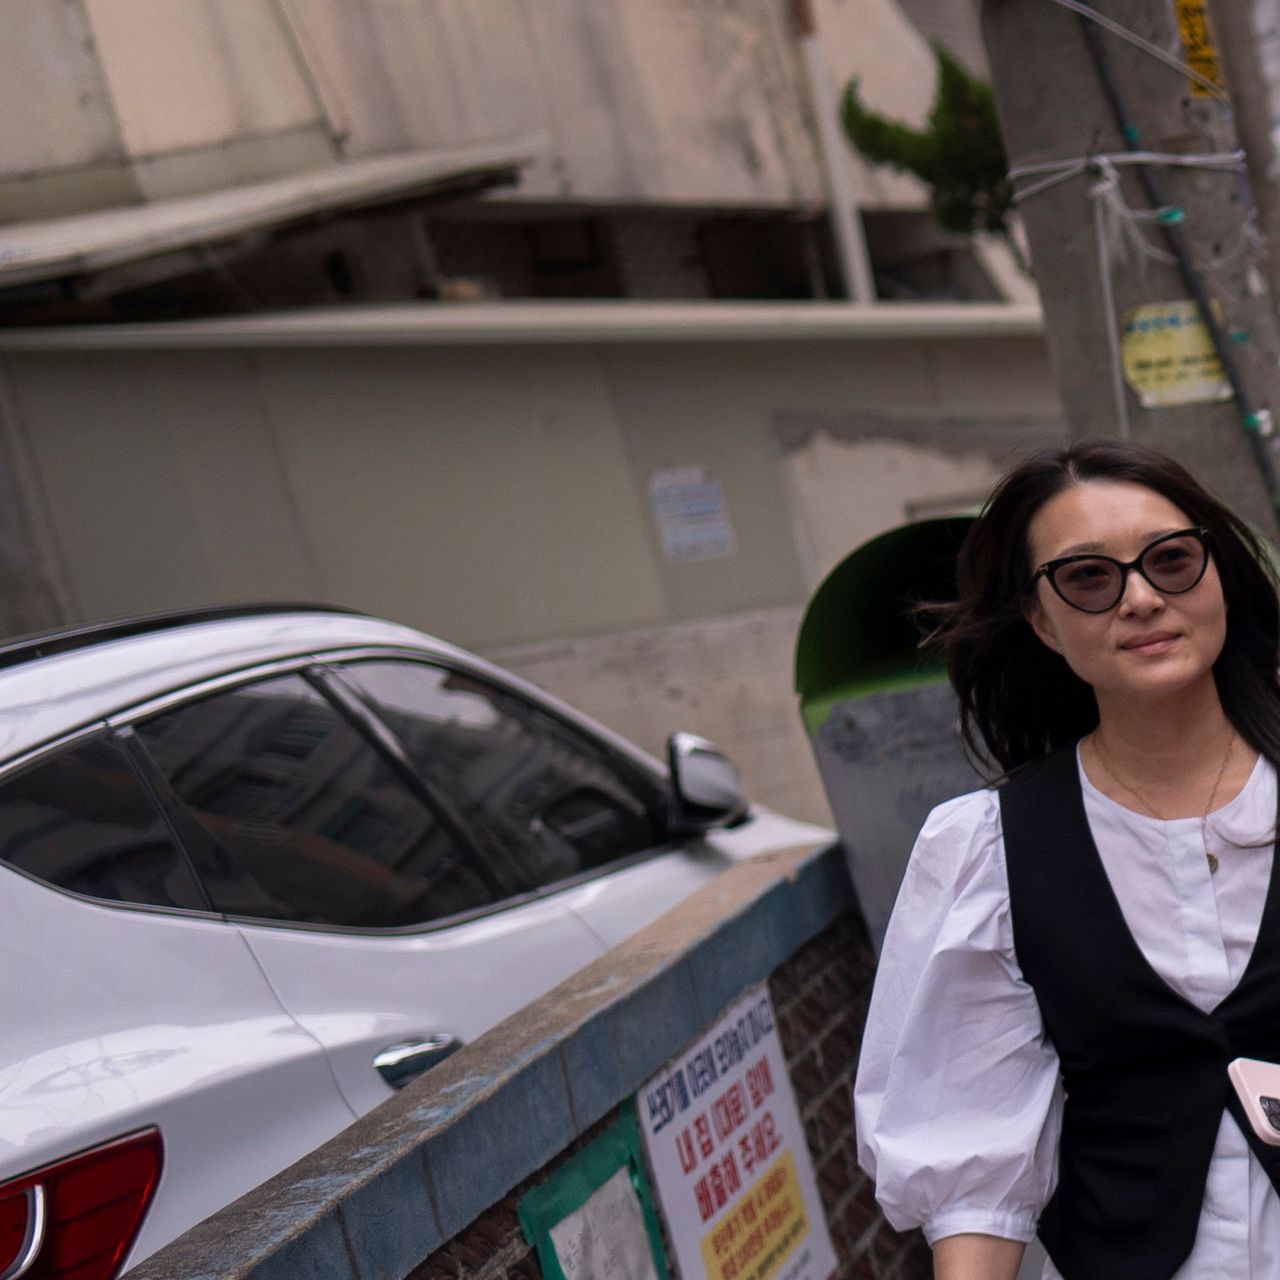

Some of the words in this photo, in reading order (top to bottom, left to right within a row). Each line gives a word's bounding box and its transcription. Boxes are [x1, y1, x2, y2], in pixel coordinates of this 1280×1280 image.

[647, 1069, 691, 1134] 쓰레기를
[686, 1044, 718, 1098] 이곳에
[675, 1127, 698, 1175] 내
[693, 1112, 714, 1158] 집
[745, 1055, 775, 1109] 앞에
